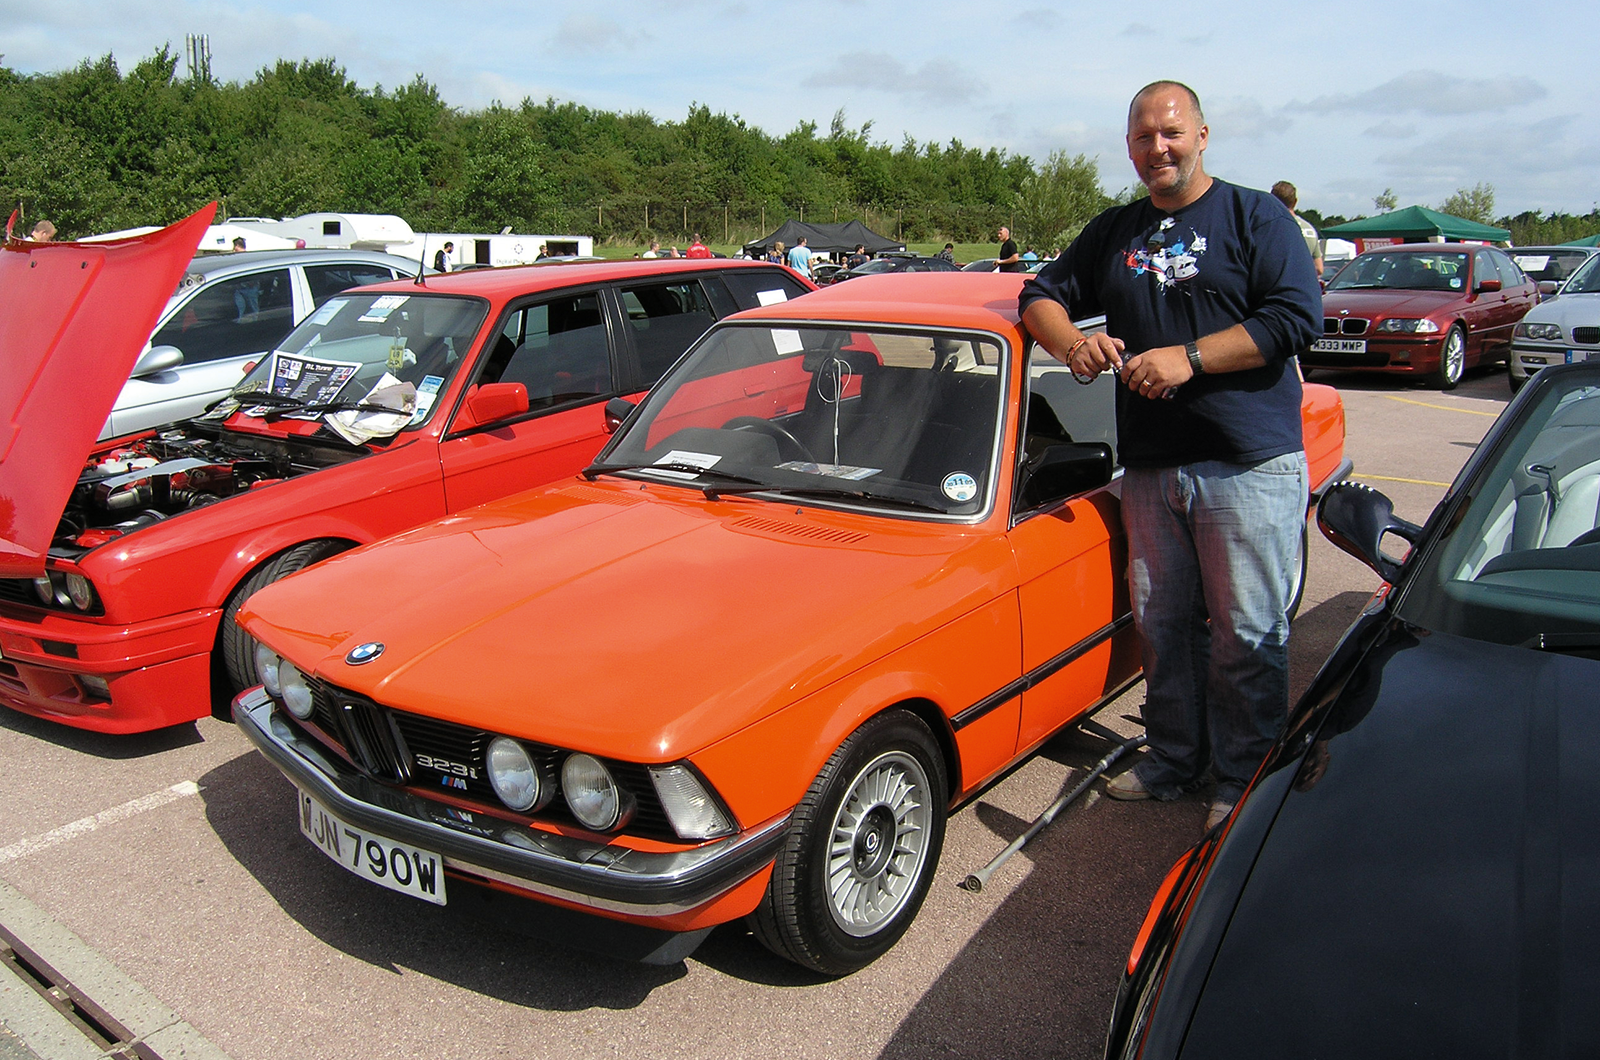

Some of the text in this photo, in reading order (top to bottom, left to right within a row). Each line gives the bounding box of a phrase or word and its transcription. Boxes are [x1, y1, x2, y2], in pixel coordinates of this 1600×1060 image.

[1341, 341, 1363, 351] MWP
[416, 753, 478, 779] 323i
[344, 828, 437, 895] 790W
